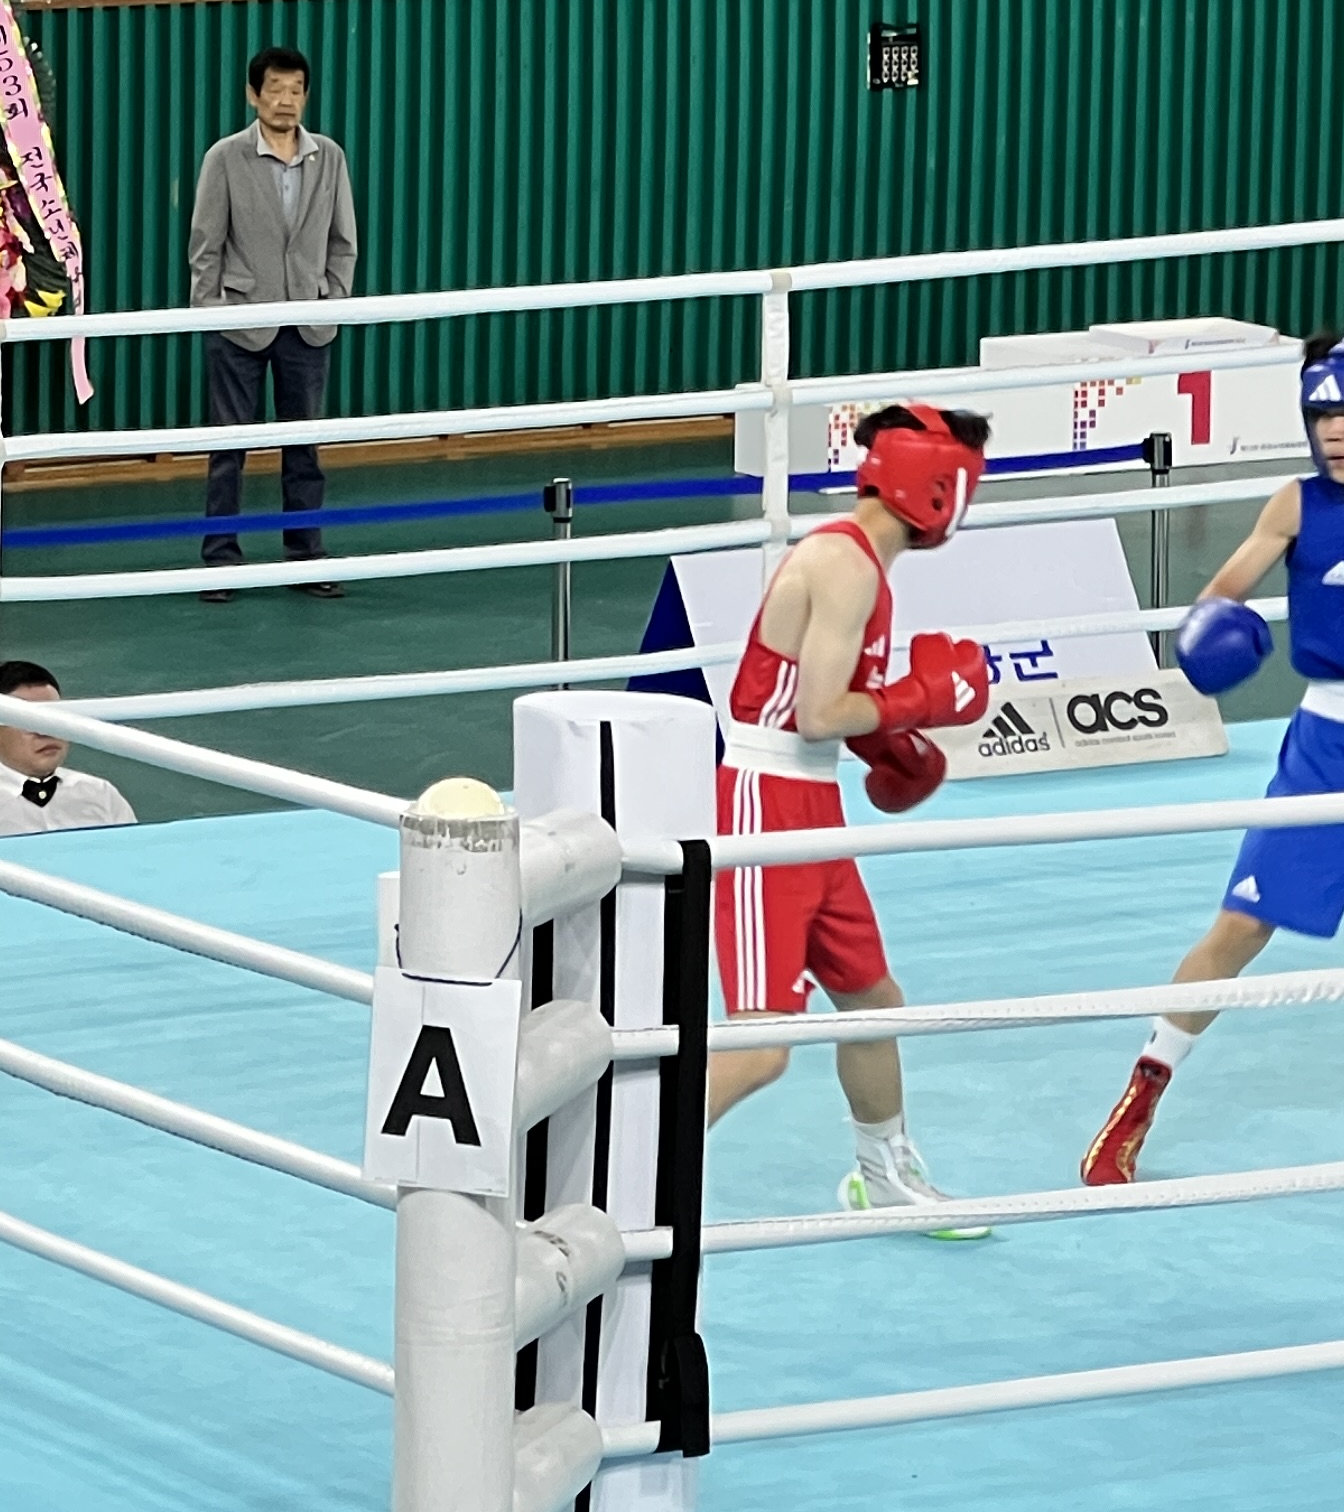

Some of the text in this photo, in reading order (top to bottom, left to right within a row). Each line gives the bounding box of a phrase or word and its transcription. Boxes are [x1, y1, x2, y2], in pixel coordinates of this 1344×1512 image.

[1177, 370, 1212, 445] 1
[978, 734, 1051, 757] adidas
[1066, 688, 1169, 734] acs
[381, 1024, 482, 1147] A
